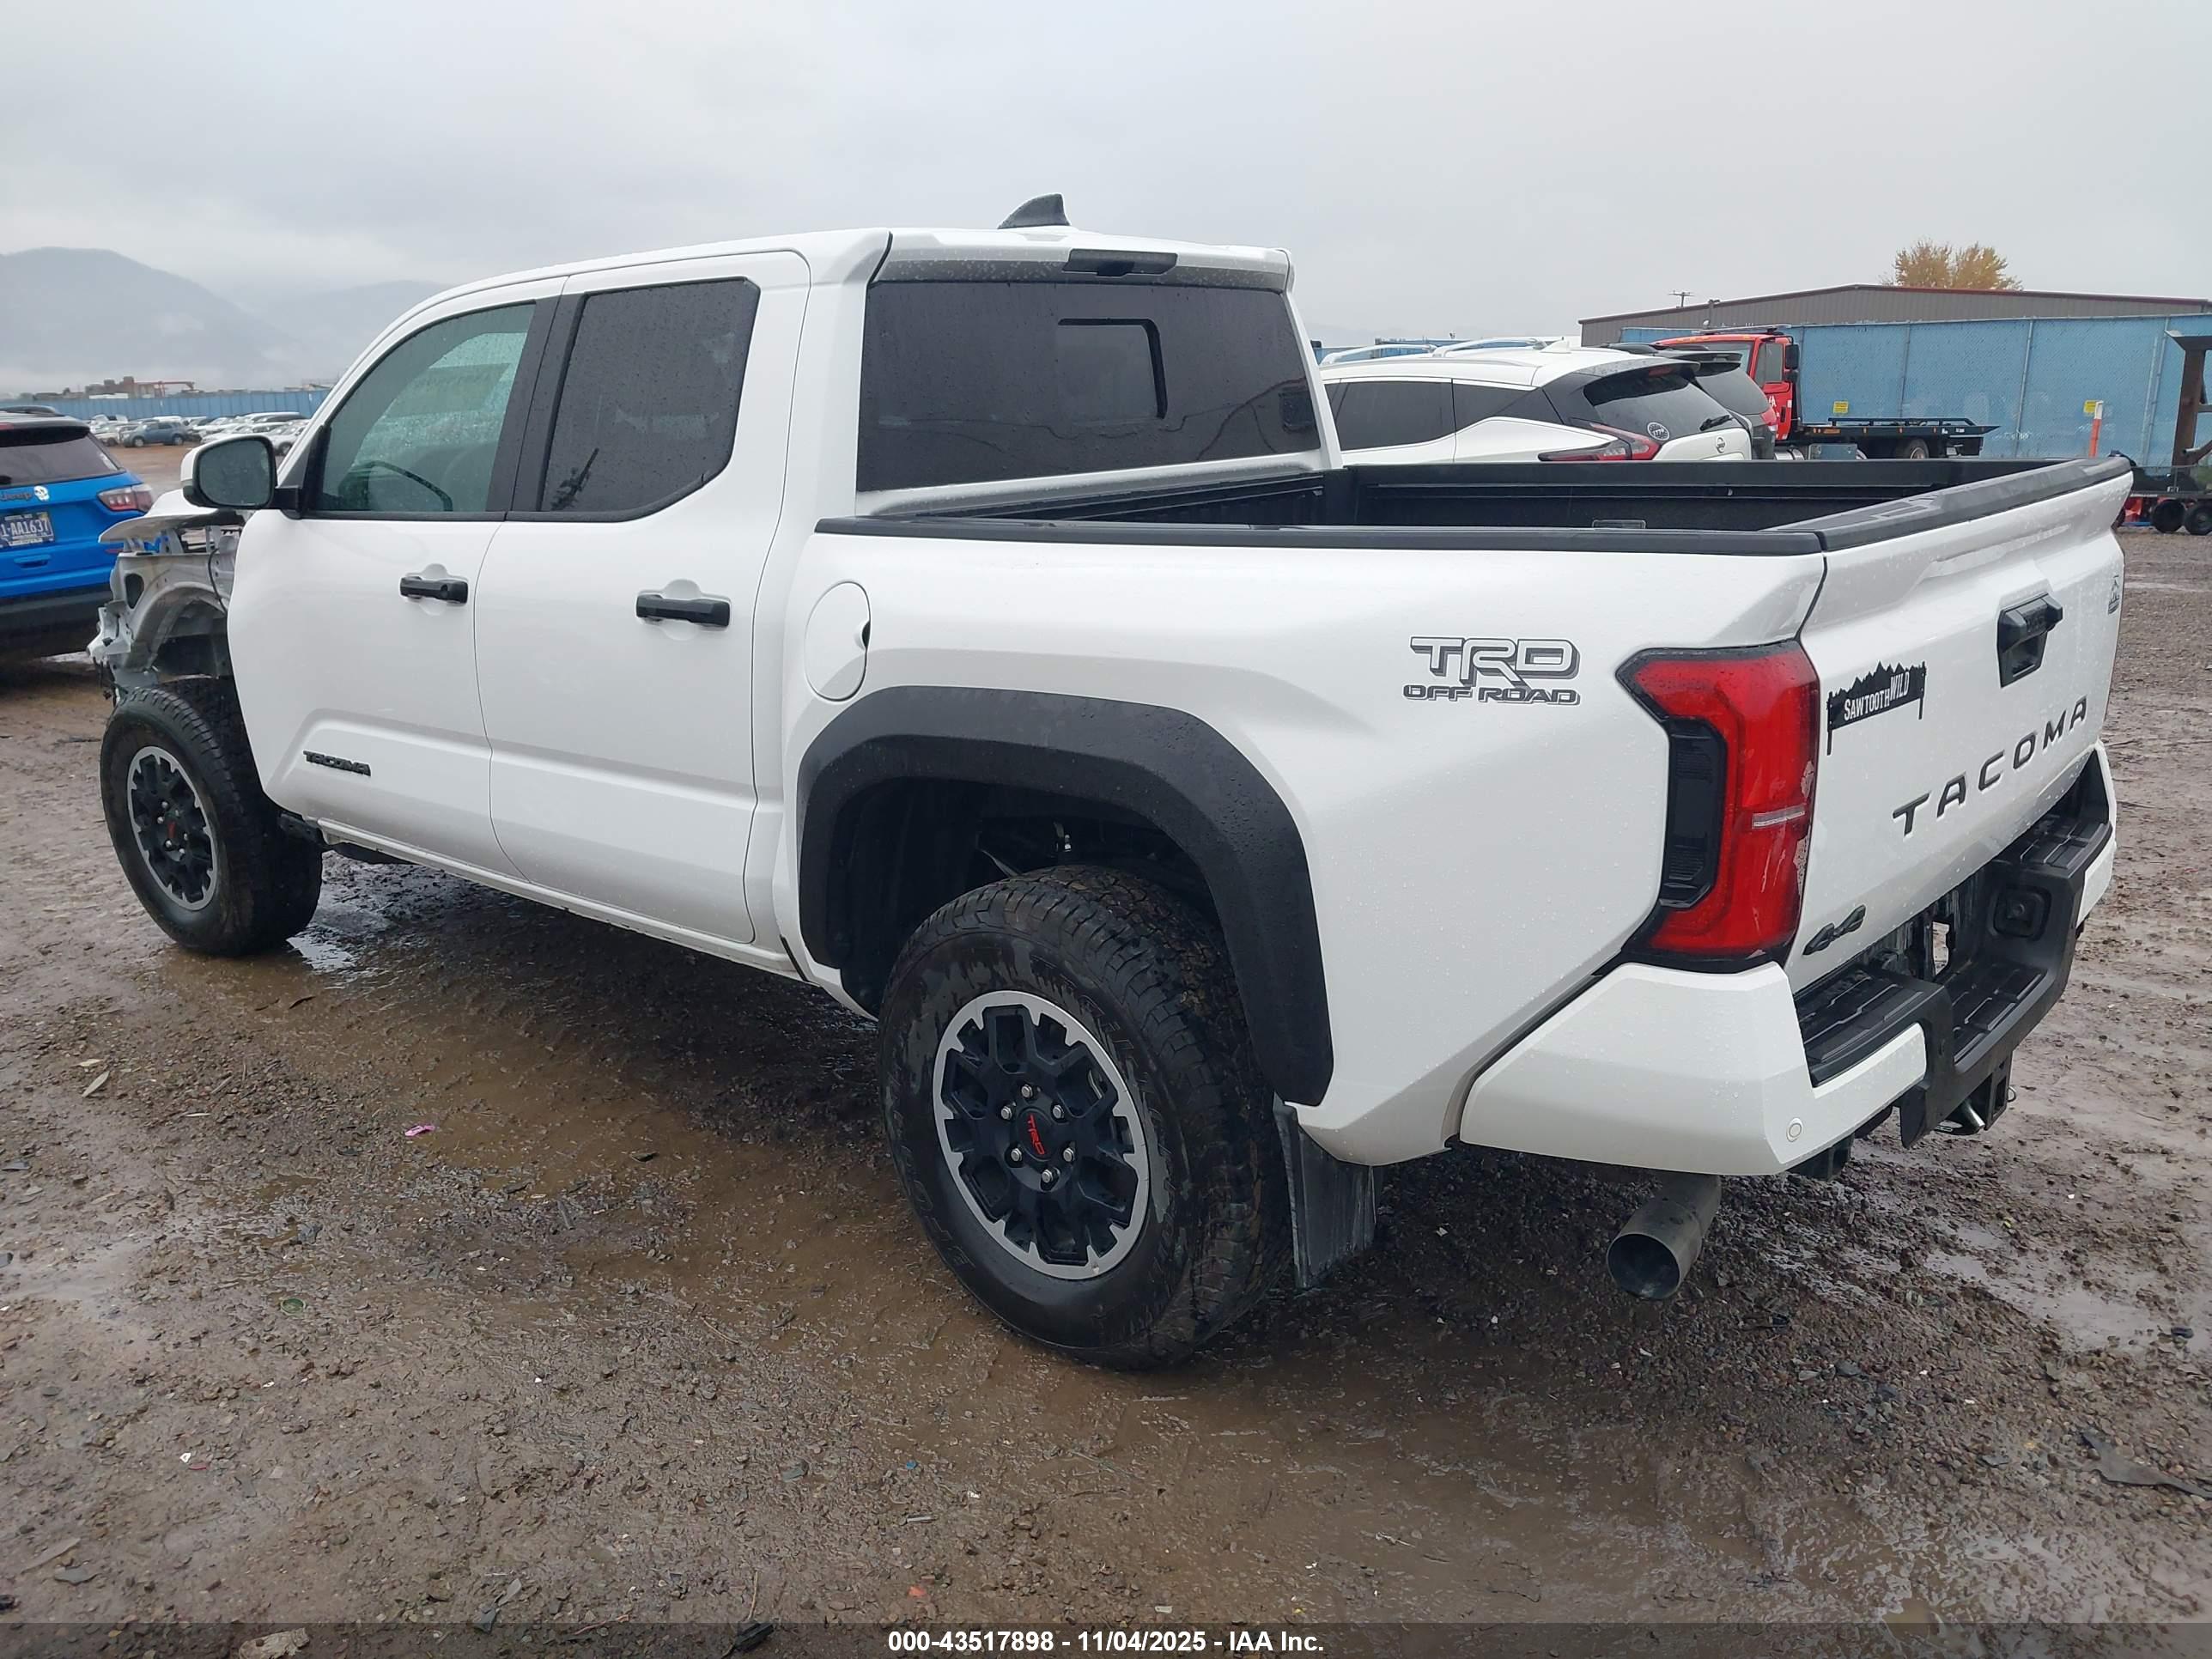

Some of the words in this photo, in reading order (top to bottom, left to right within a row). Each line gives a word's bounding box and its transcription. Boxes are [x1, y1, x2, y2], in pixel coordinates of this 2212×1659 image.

[1410, 636, 1581, 689] TRD
[1403, 684, 1474, 702] OFF
[1478, 687, 1581, 706] ROAD
[302, 750, 371, 777] TACOMA
[1892, 695, 2088, 839] TACOMA
[1027, 1114, 1045, 1156] TRD
